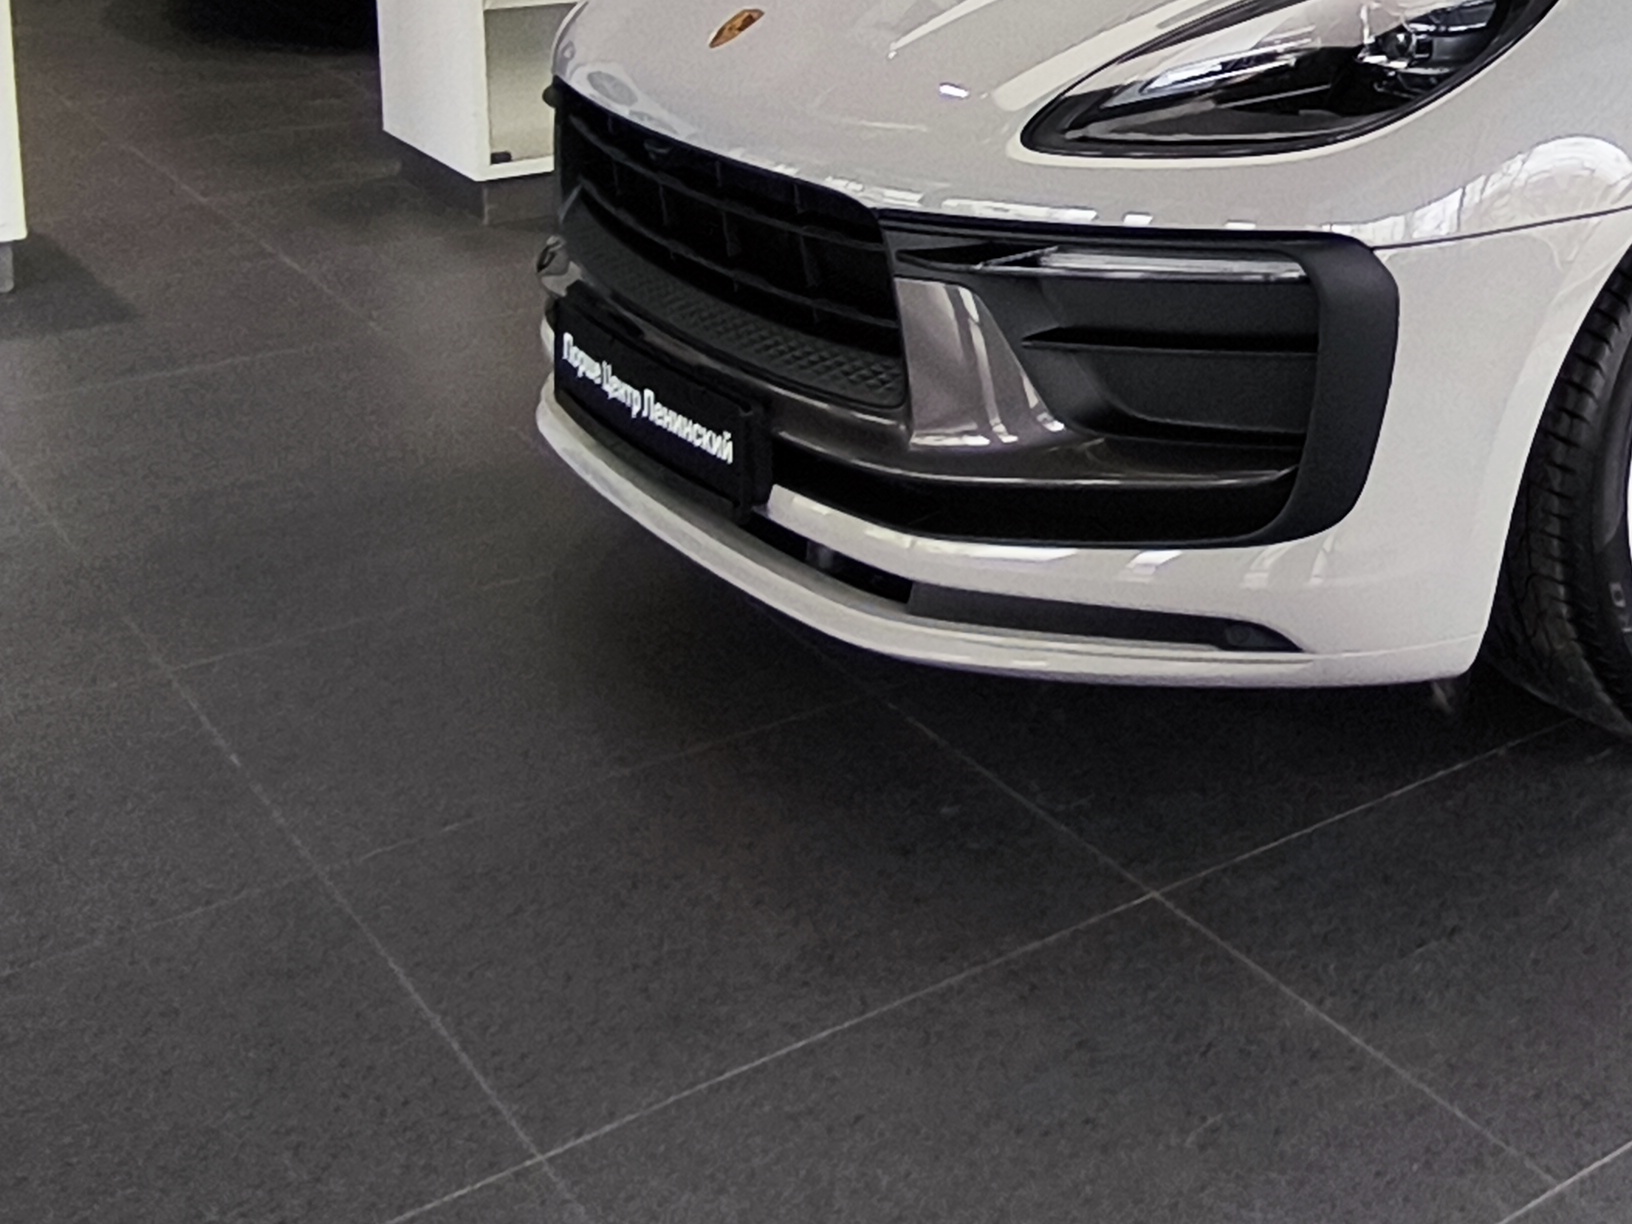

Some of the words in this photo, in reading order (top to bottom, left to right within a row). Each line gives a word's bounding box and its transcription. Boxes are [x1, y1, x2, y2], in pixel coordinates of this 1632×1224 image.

[562, 332, 602, 385] Порше
[601, 360, 642, 419] Центр
[641, 388, 734, 465] Ленинский
